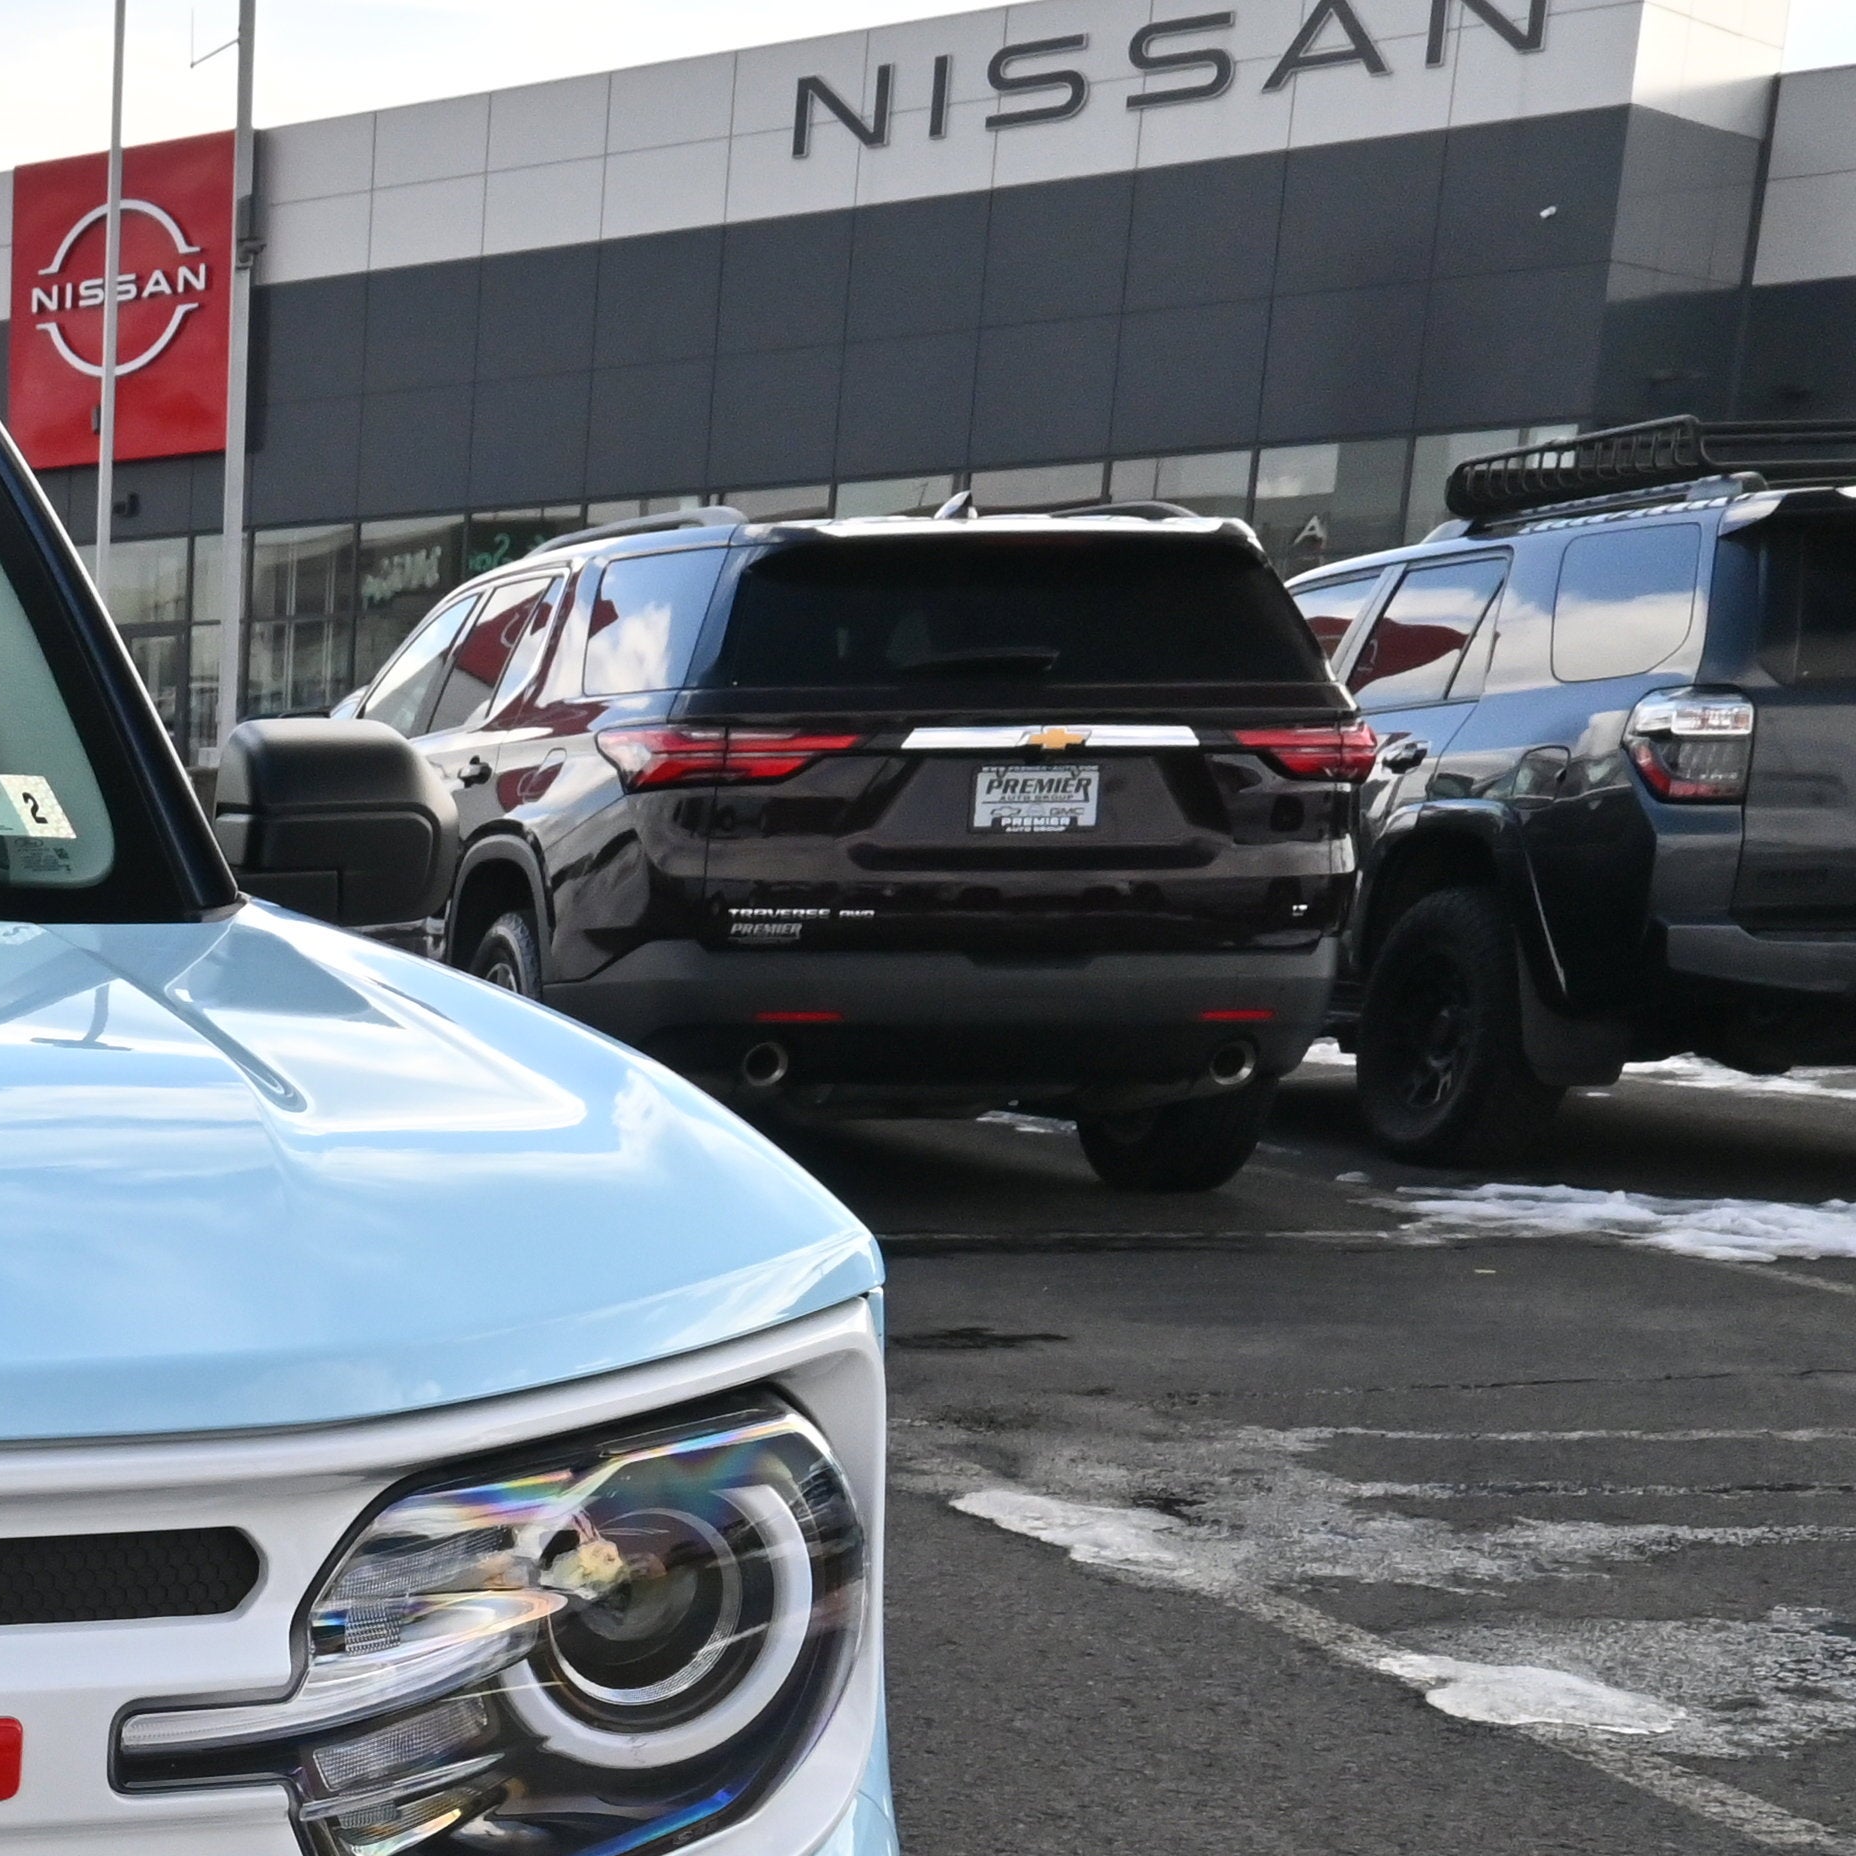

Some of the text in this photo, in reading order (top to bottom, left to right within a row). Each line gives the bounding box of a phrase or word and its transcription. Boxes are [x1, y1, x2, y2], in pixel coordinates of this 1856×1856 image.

[790, 0, 1548, 160] NISSAN
[30, 262, 207, 315] NISSAN
[985, 777, 1093, 802] PREMIER
[22, 791, 49, 825] 2
[1049, 807, 1086, 817] GMC
[1000, 816, 1072, 828] PREMIER
[728, 908, 876, 919] TRAVERSE AWD
[730, 923, 803, 940] PREMIER
